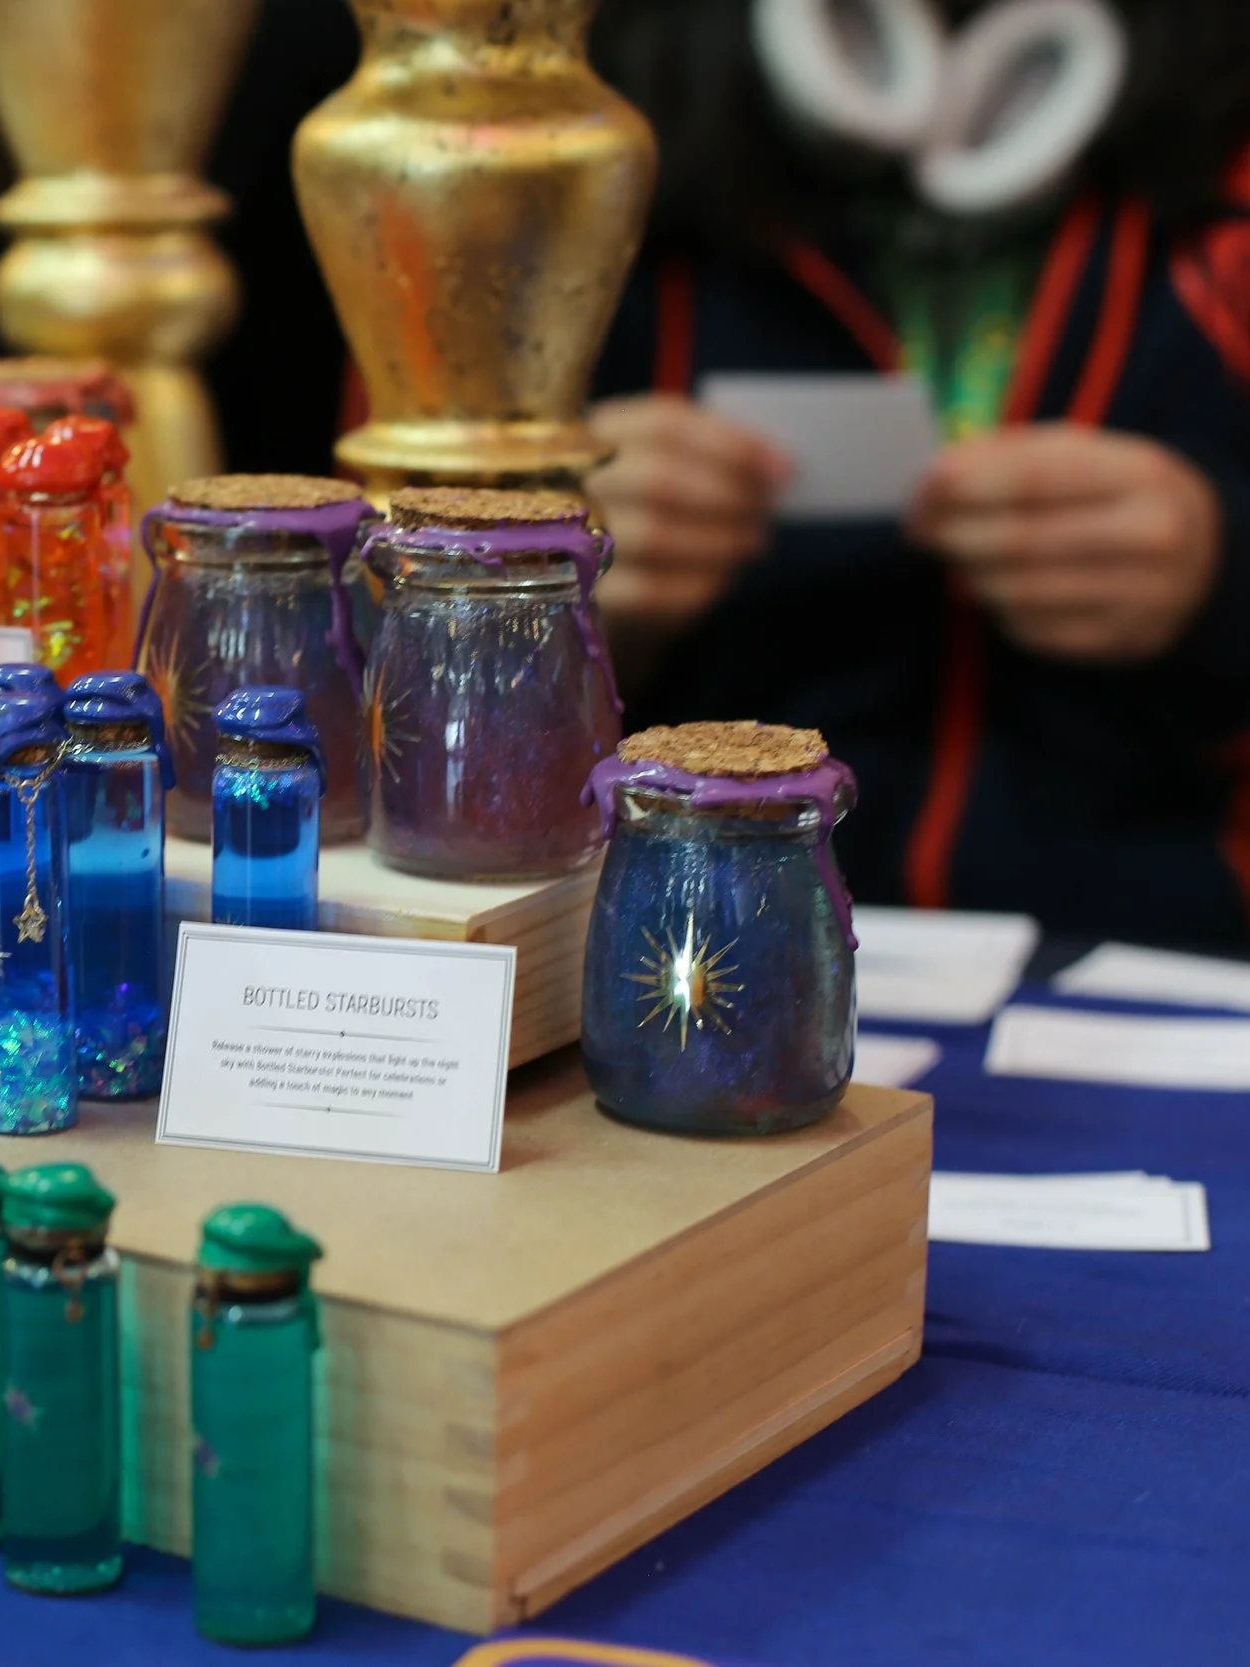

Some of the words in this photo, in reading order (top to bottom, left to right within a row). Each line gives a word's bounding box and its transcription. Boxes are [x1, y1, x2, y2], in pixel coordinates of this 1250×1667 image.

[243, 985, 320, 1010] BOTTLED
[325, 991, 439, 1019] STARBURSTS
[212, 1039, 244, 1052] Release
[252, 1044, 283, 1055] shower
[285, 1046, 294, 1056] of
[295, 1047, 321, 1060] starry
[322, 1050, 367, 1063] explosions
[368, 1053, 386, 1064] that
[387, 1054, 406, 1066] light
[408, 1058, 420, 1068] up
[421, 1057, 435, 1067] the
[436, 1059, 459, 1070] night
[220, 1058, 235, 1070] sky
[236, 1059, 255, 1069] with
[256, 1060, 286, 1072] Bottled
[335, 1066, 367, 1079] Perfect
[369, 1070, 381, 1081] for
[383, 1072, 435, 1085] celebrations
[436, 1077, 447, 1086] or
[248, 1077, 278, 1091] adding
[285, 1081, 311, 1091] touch
[312, 1082, 321, 1092] of
[322, 1083, 348, 1096] magic
[350, 1085, 359, 1095] to
[360, 1088, 377, 1099] any
[378, 1089, 413, 1100] moment
